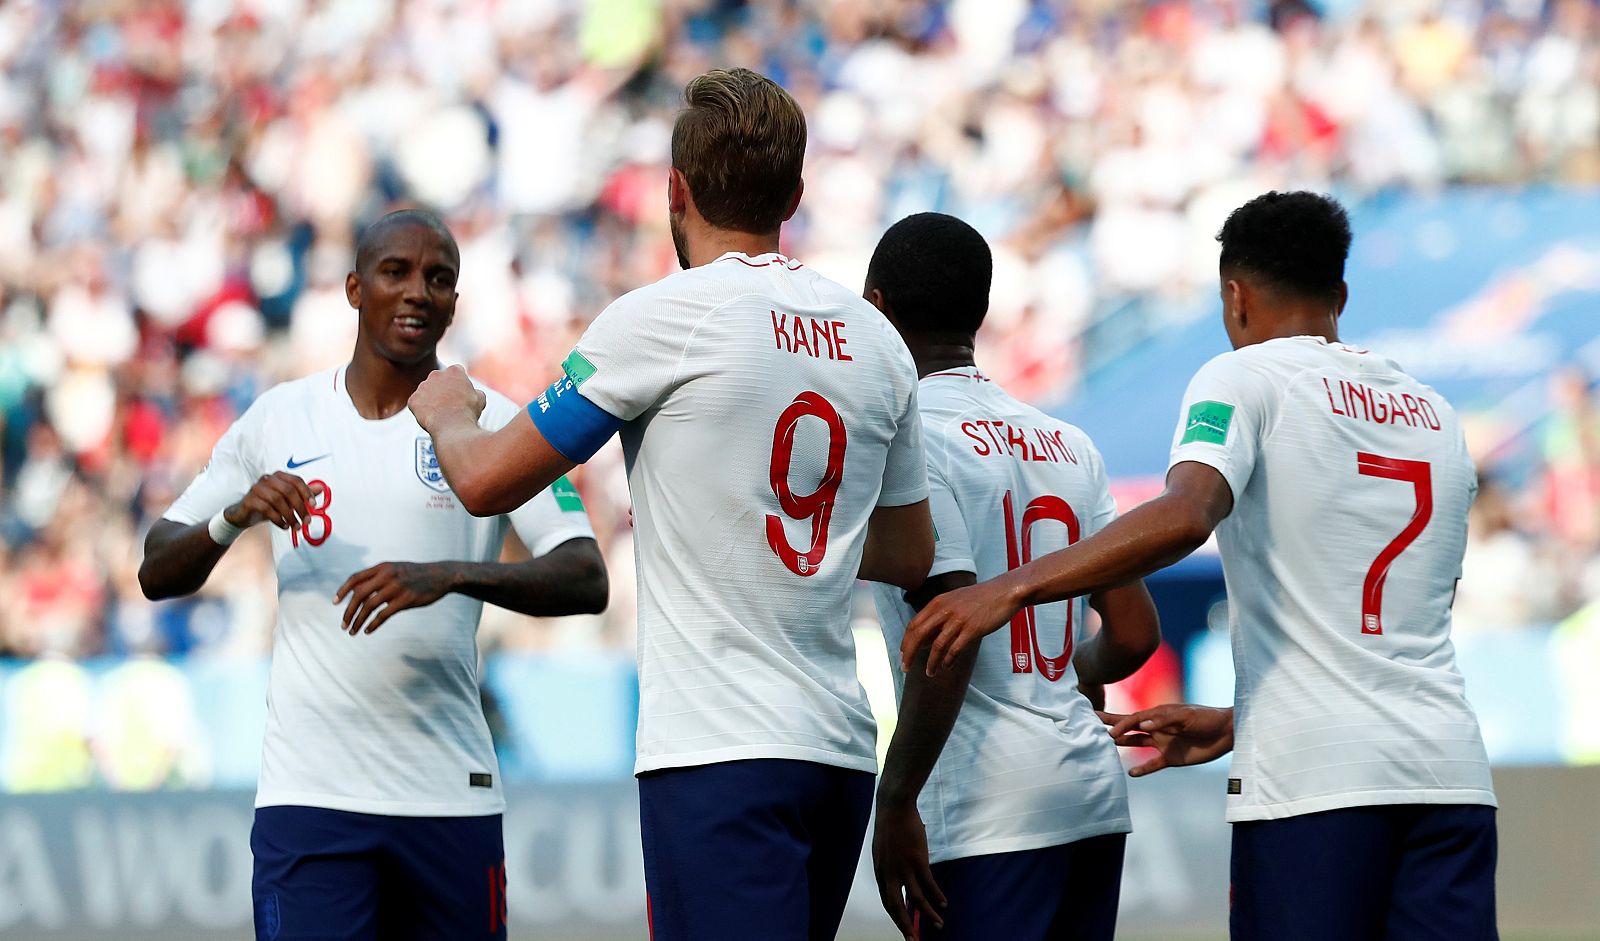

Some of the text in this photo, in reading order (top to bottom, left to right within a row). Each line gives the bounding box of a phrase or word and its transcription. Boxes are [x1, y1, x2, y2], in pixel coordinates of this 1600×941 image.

[771, 310, 853, 361] KANE
[1322, 377, 1442, 431] LINGARD
[765, 390, 848, 577] 9
[1356, 451, 1433, 636] 7
[1002, 489, 1081, 682] 10
